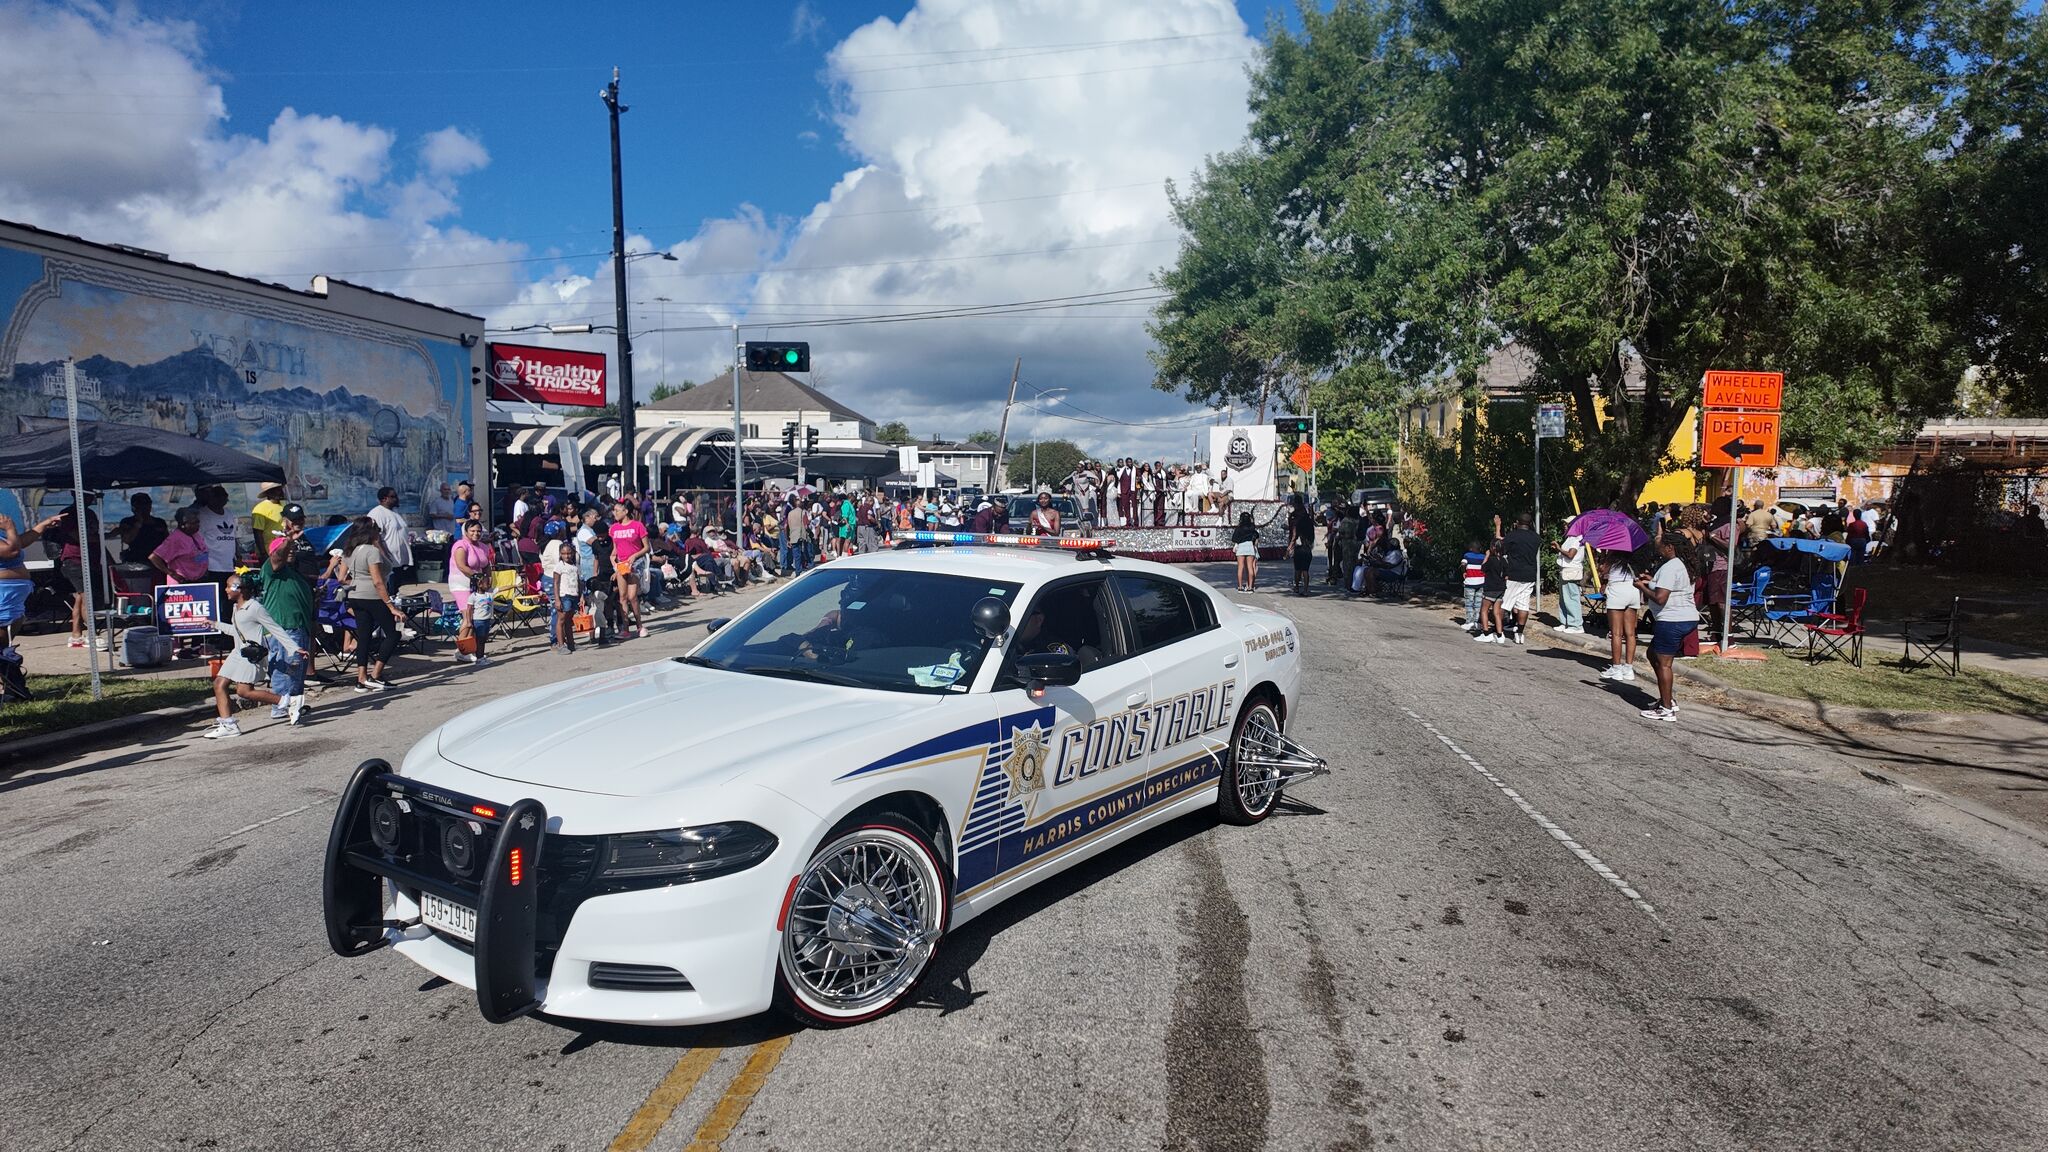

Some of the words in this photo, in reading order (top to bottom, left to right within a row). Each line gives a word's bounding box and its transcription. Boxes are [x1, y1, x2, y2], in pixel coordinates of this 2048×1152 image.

[245, 370, 257, 384] IS
[525, 360, 602, 383] Healthy
[525, 374, 590, 391] STRIDES
[1712, 375, 1776, 388] WHEELER
[1715, 392, 1771, 405] AVENUE
[1713, 420, 1773, 434] DETOUR
[1232, 440, 1248, 455] 98
[1180, 530, 1211, 538] TSU
[1195, 538, 1214, 546] COURT
[164, 600, 210, 618] PEAKE
[1053, 679, 1236, 788] CONSTABLE
[422, 791, 453, 807] SETINA
[1023, 816, 1082, 855] HARRIS
[1088, 790, 1143, 824] COUNTY
[1148, 768, 1207, 799] PRECINCT
